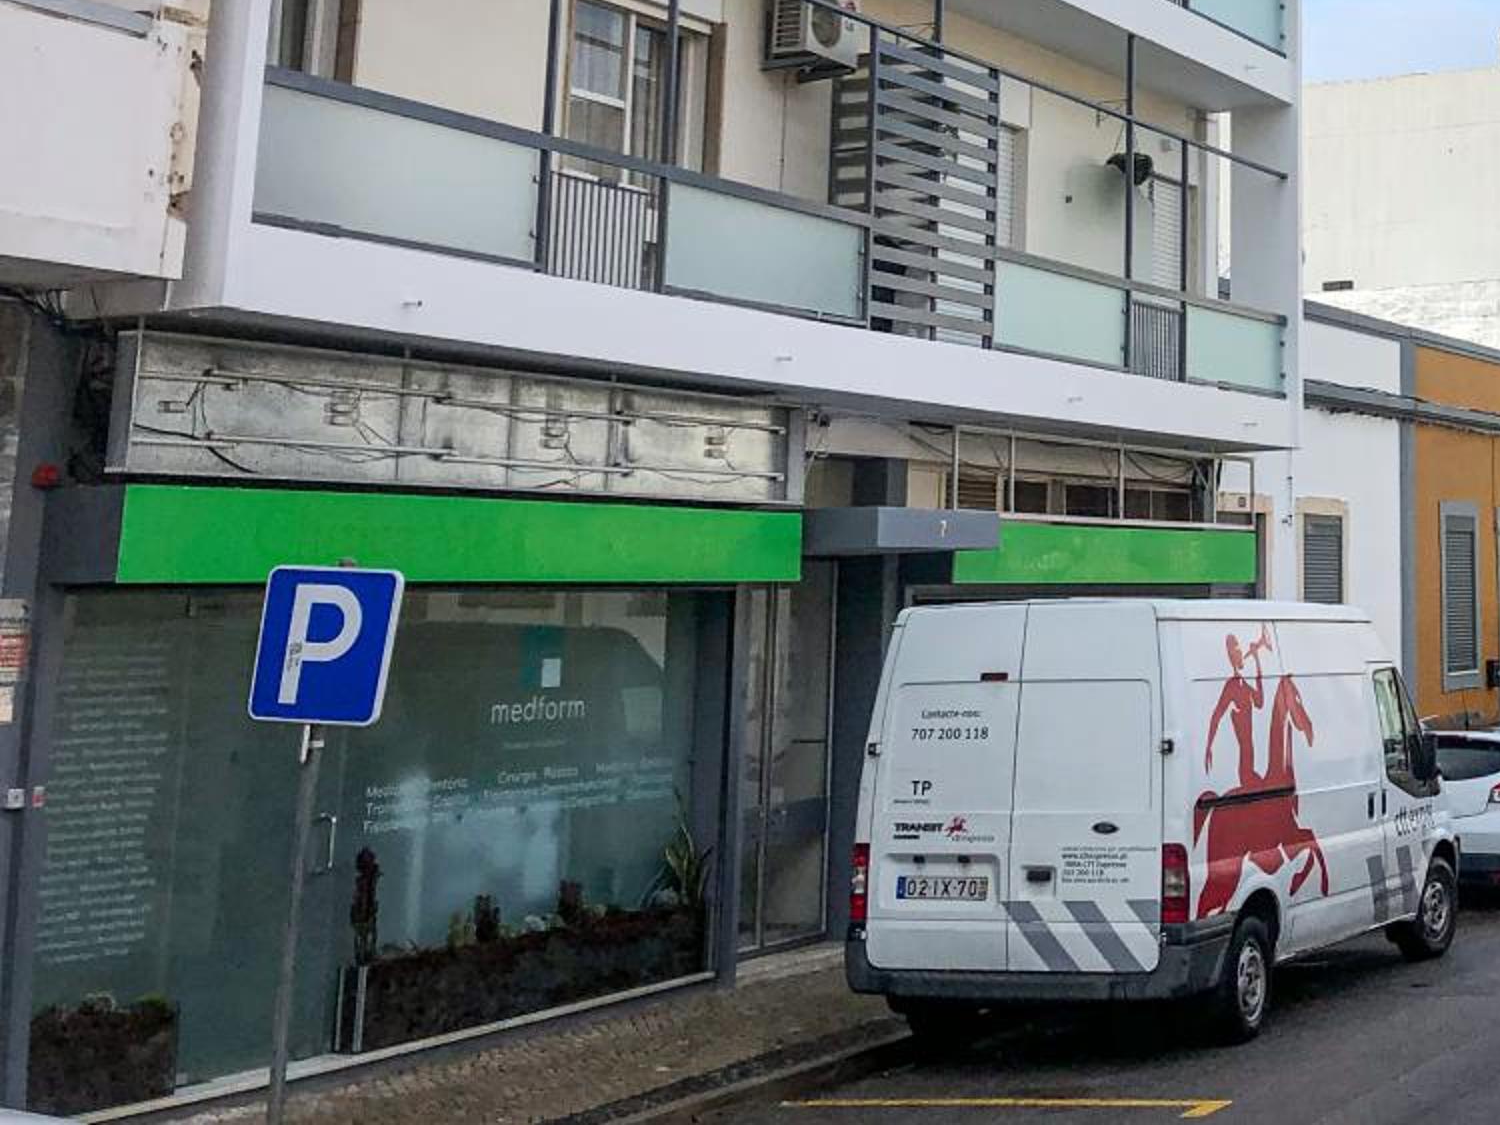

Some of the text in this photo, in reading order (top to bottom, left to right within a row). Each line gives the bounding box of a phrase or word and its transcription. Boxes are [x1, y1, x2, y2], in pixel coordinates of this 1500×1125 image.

[277, 583, 362, 704] P
[490, 695, 586, 724] medform
[911, 726, 989, 741] 707 200 118
[911, 779, 933, 796] TP
[894, 822, 945, 832] TRANSIT
